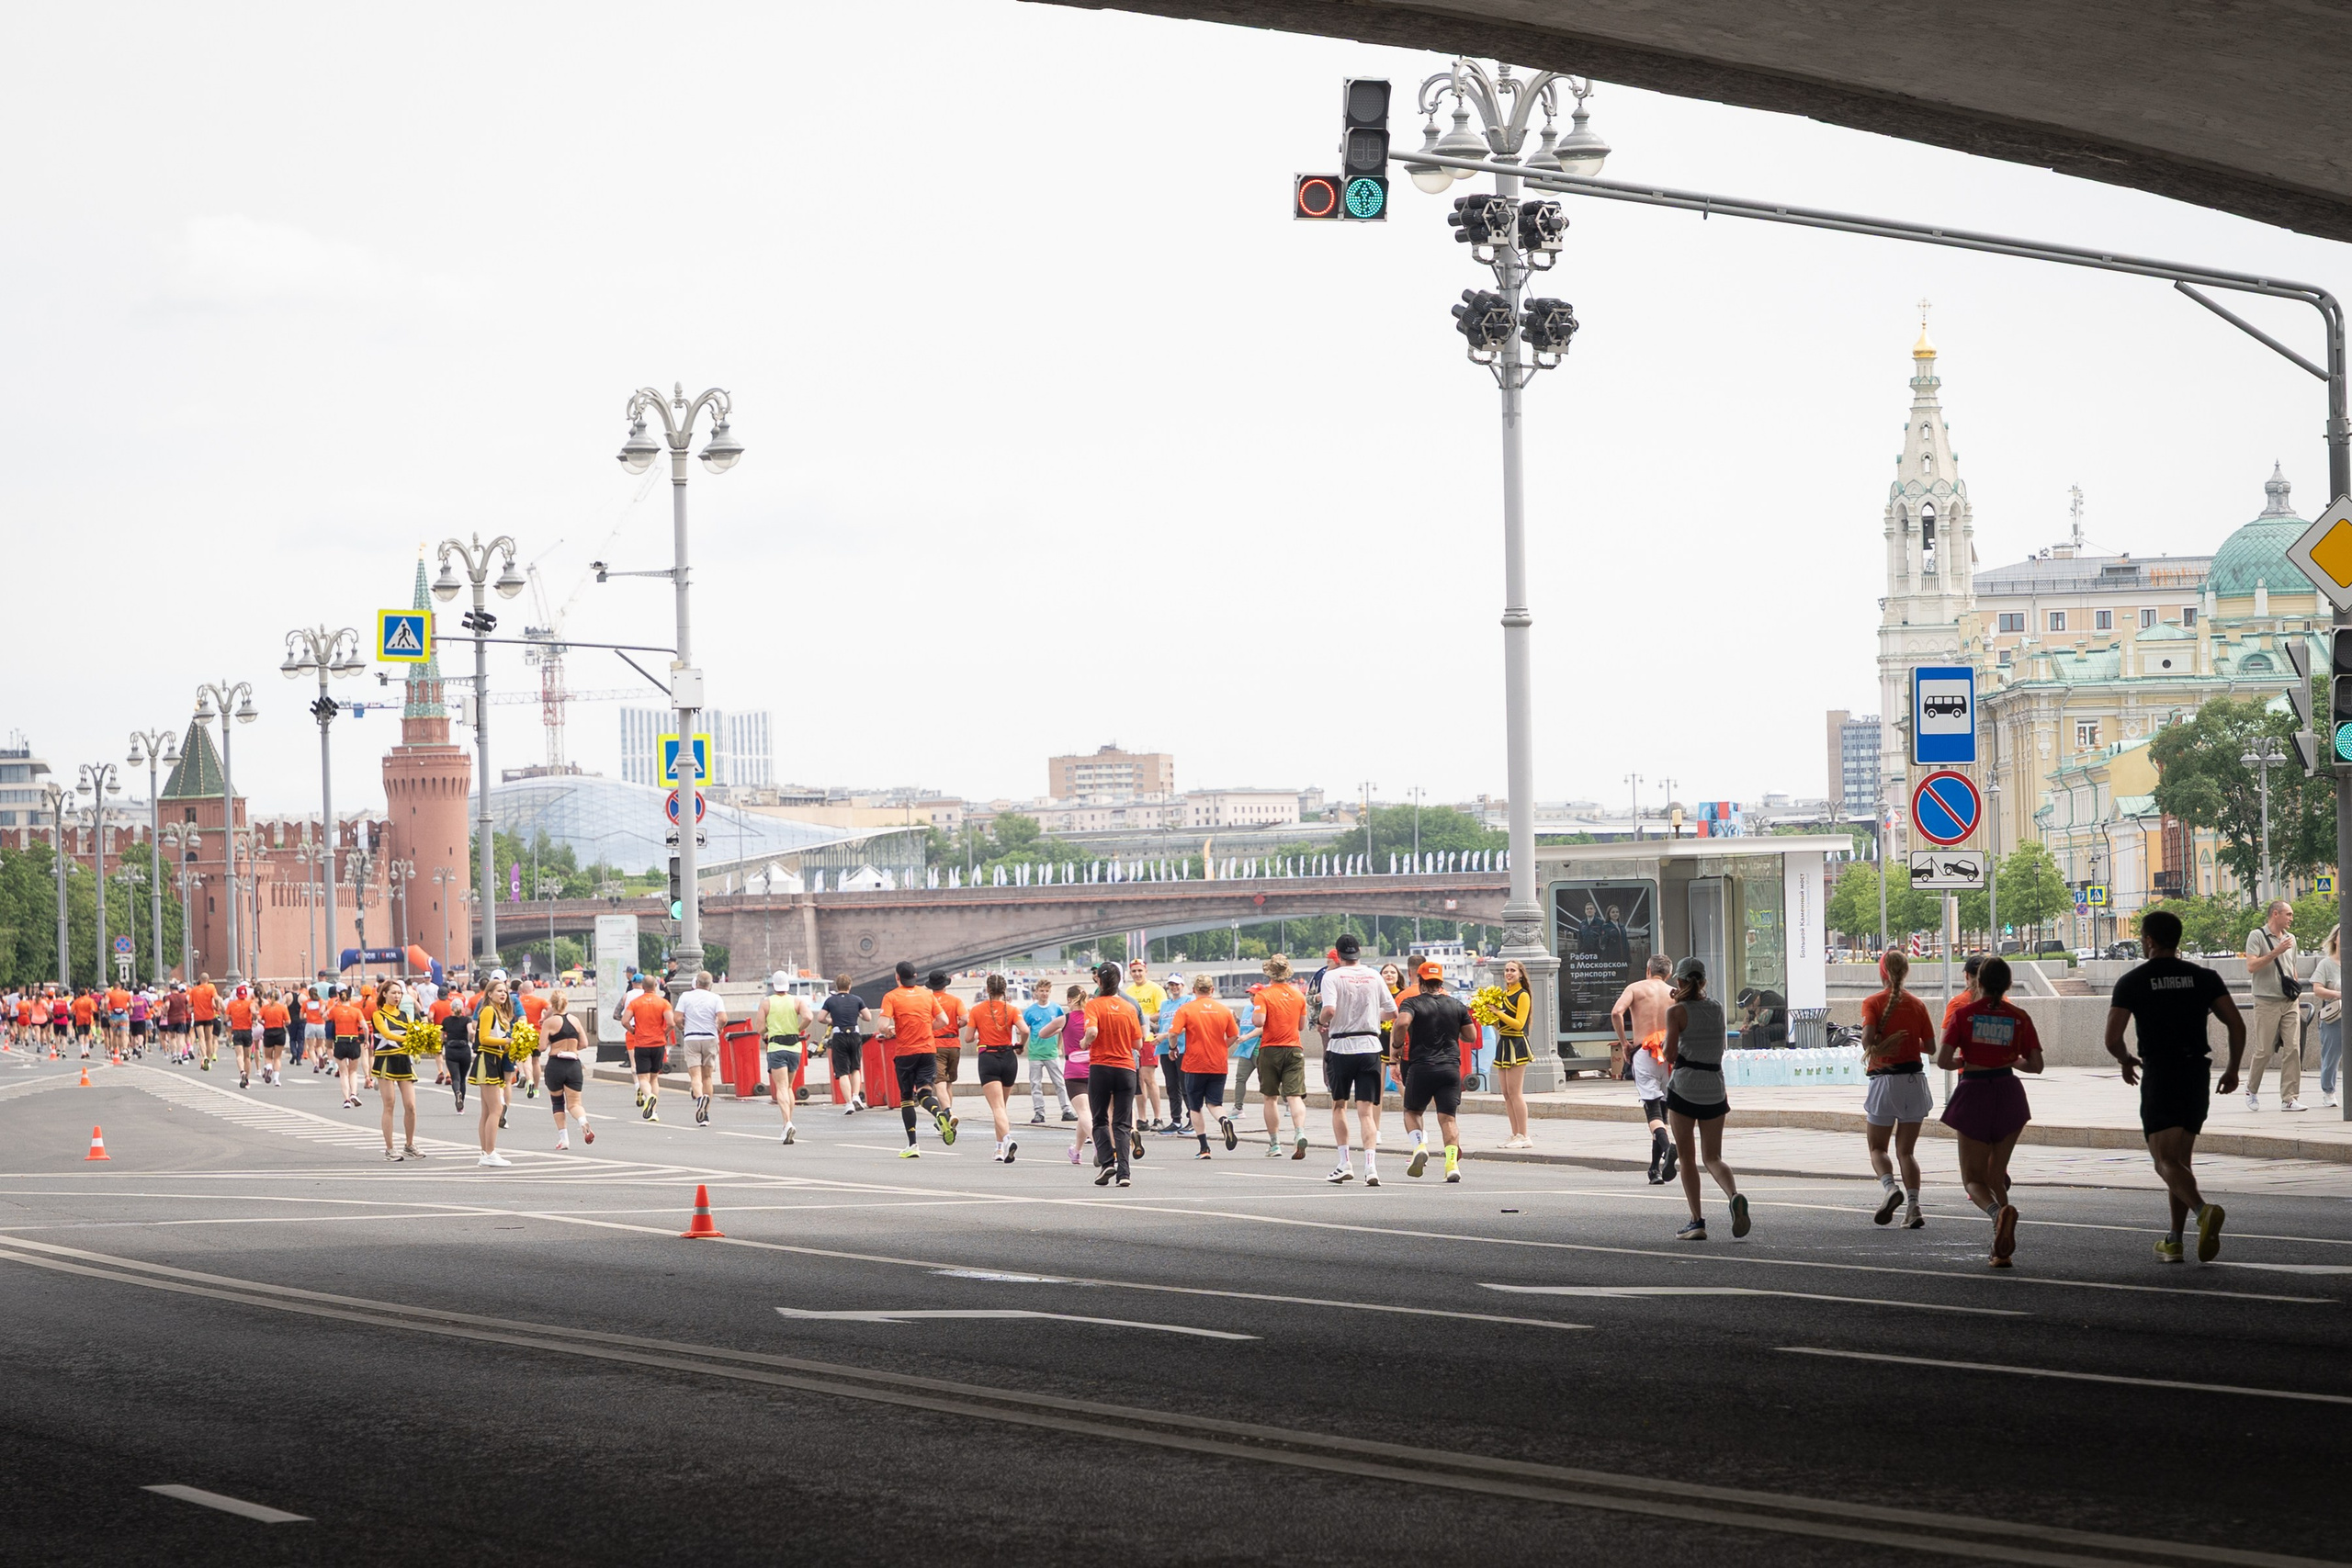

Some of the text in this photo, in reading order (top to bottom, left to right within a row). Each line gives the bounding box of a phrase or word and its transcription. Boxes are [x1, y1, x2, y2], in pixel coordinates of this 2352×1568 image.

[1570, 953, 1598, 961] Работа
[1570, 971, 1617, 979] транспорте
[2150, 976, 2194, 990] БАЛЯБИН
[1975, 1021, 2012, 1039] 70079
